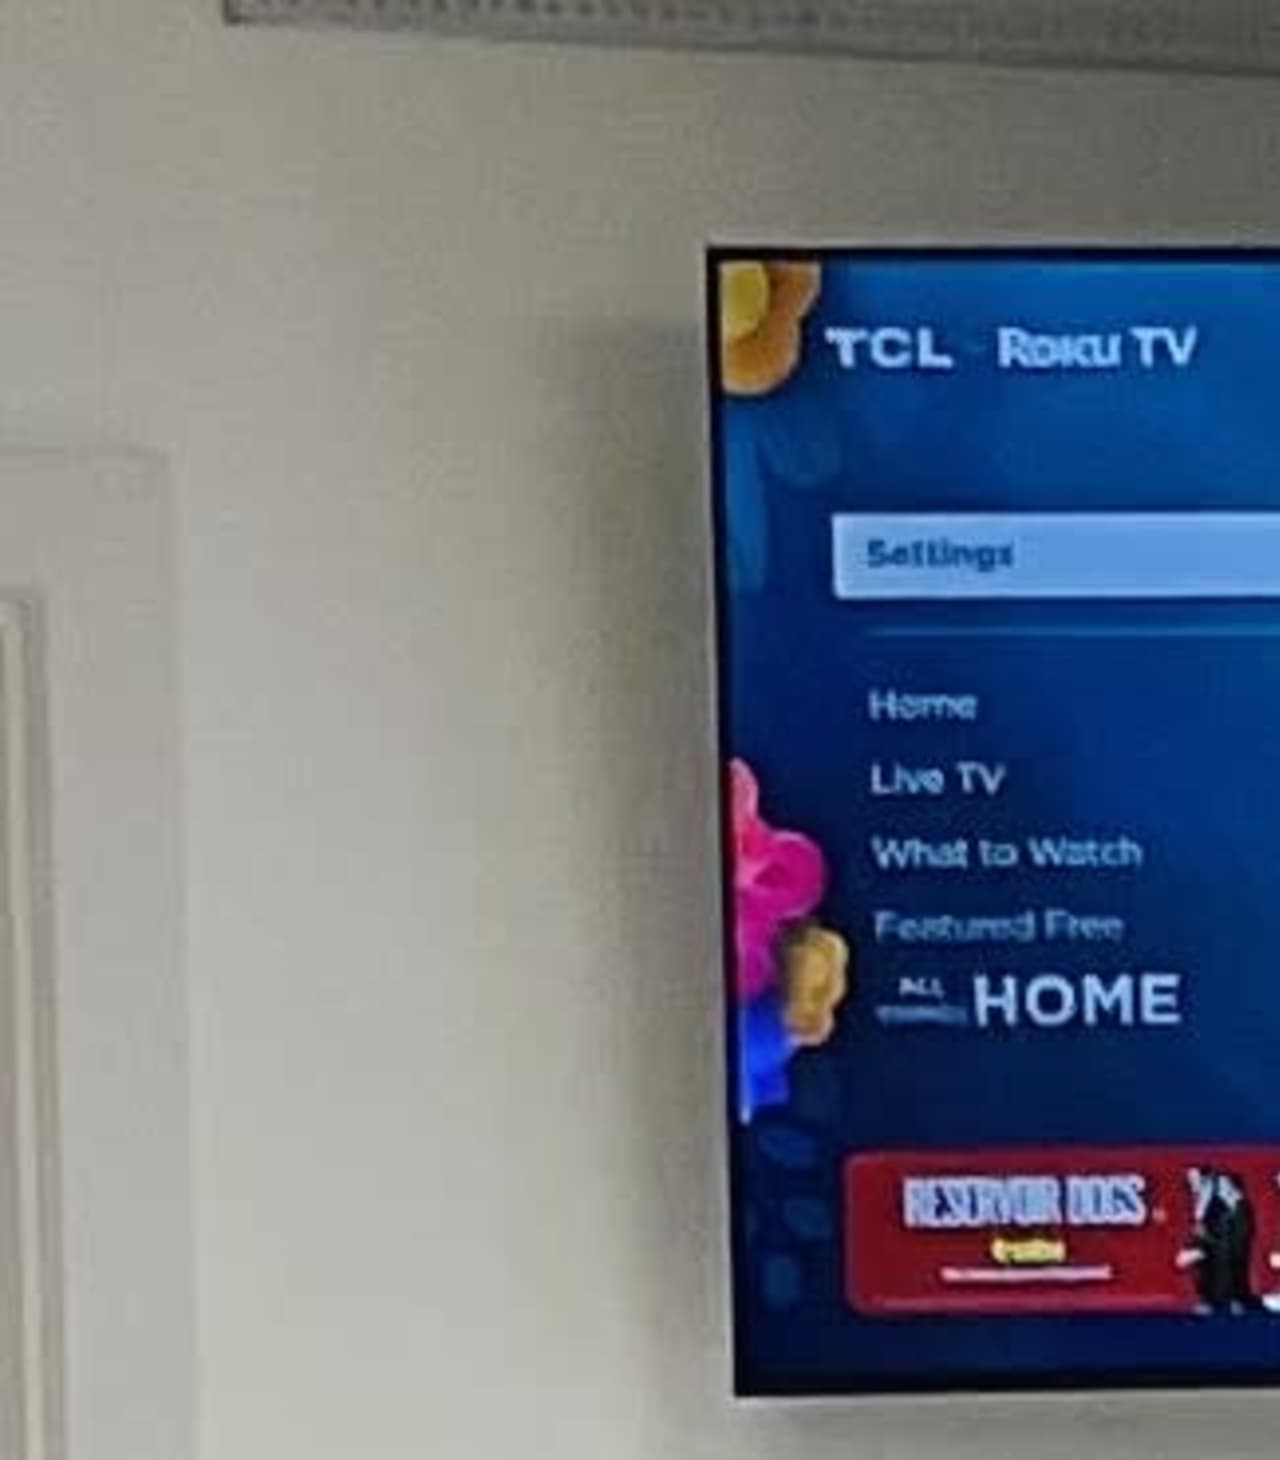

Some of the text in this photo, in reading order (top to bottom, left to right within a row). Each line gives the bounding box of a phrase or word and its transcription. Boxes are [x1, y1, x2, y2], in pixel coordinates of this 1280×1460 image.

[825, 326, 954, 368] TCL
[1130, 326, 1197, 367] TV
[866, 539, 1014, 573] Settings
[868, 688, 979, 721] Home
[871, 762, 1007, 796] Live TV
[872, 836, 1144, 870] What to Watch
[874, 908, 1125, 943] Featured Free
[974, 972, 1183, 1028] HOME
